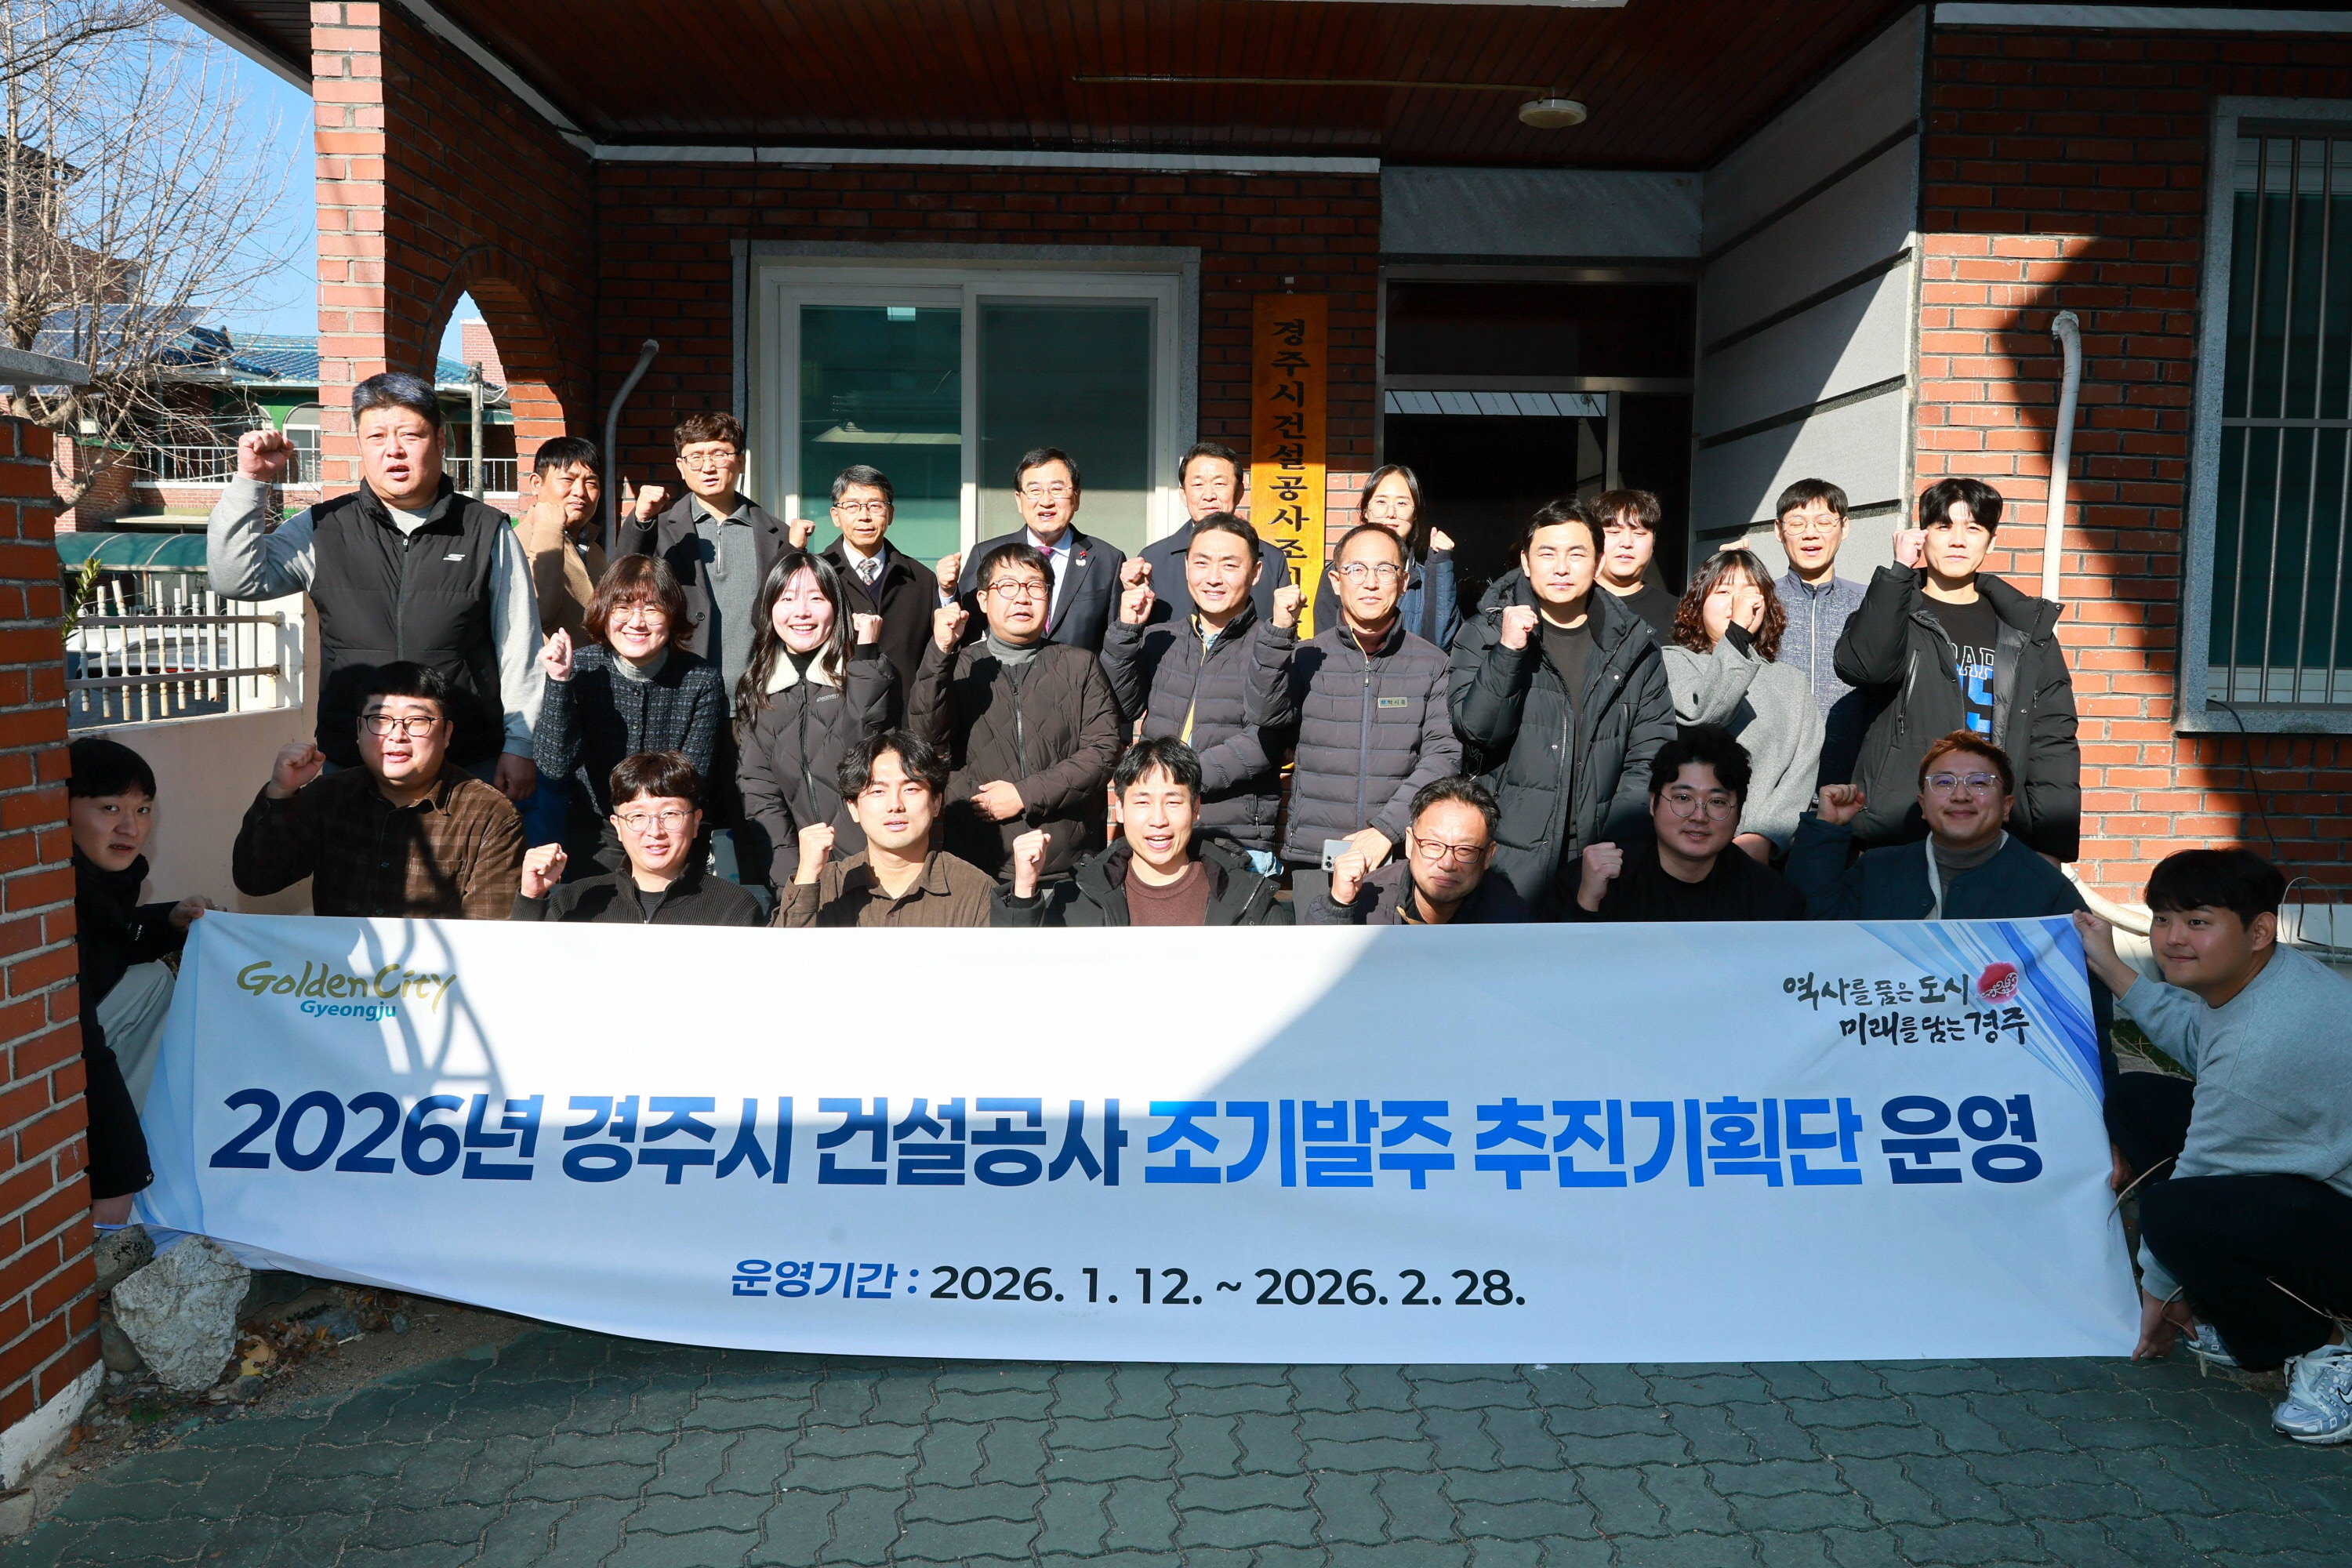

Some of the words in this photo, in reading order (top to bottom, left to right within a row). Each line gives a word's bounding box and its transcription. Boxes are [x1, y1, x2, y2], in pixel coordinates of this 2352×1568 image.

[237, 960, 368, 998] Golden
[373, 964, 457, 1014] City
[1783, 972, 1873, 1011] 역사를
[1918, 973, 1969, 1006] 도시
[300, 1000, 397, 1022] Gyeongju
[1839, 1011, 1919, 1046] 미래를
[1922, 1015, 1965, 1044] 담는
[1964, 1007, 2030, 1045] 경주
[209, 1088, 544, 1181] 2026년
[562, 1094, 796, 1186] 경주시
[816, 1096, 1129, 1188] 건설공사
[1145, 1098, 1455, 1190] 조기발주
[1475, 1095, 1864, 1190] 추진기획단
[1881, 1094, 2044, 1185] 운영
[731, 1259, 899, 1300] 운영기간
[931, 1266, 1065, 1303] 2026.
[1083, 1268, 1119, 1305] 1.
[1137, 1268, 1203, 1305] 12.
[1255, 1269, 1389, 1306] 2026.
[1399, 1269, 1443, 1306] 2.
[1452, 1270, 1526, 1307] 28.
